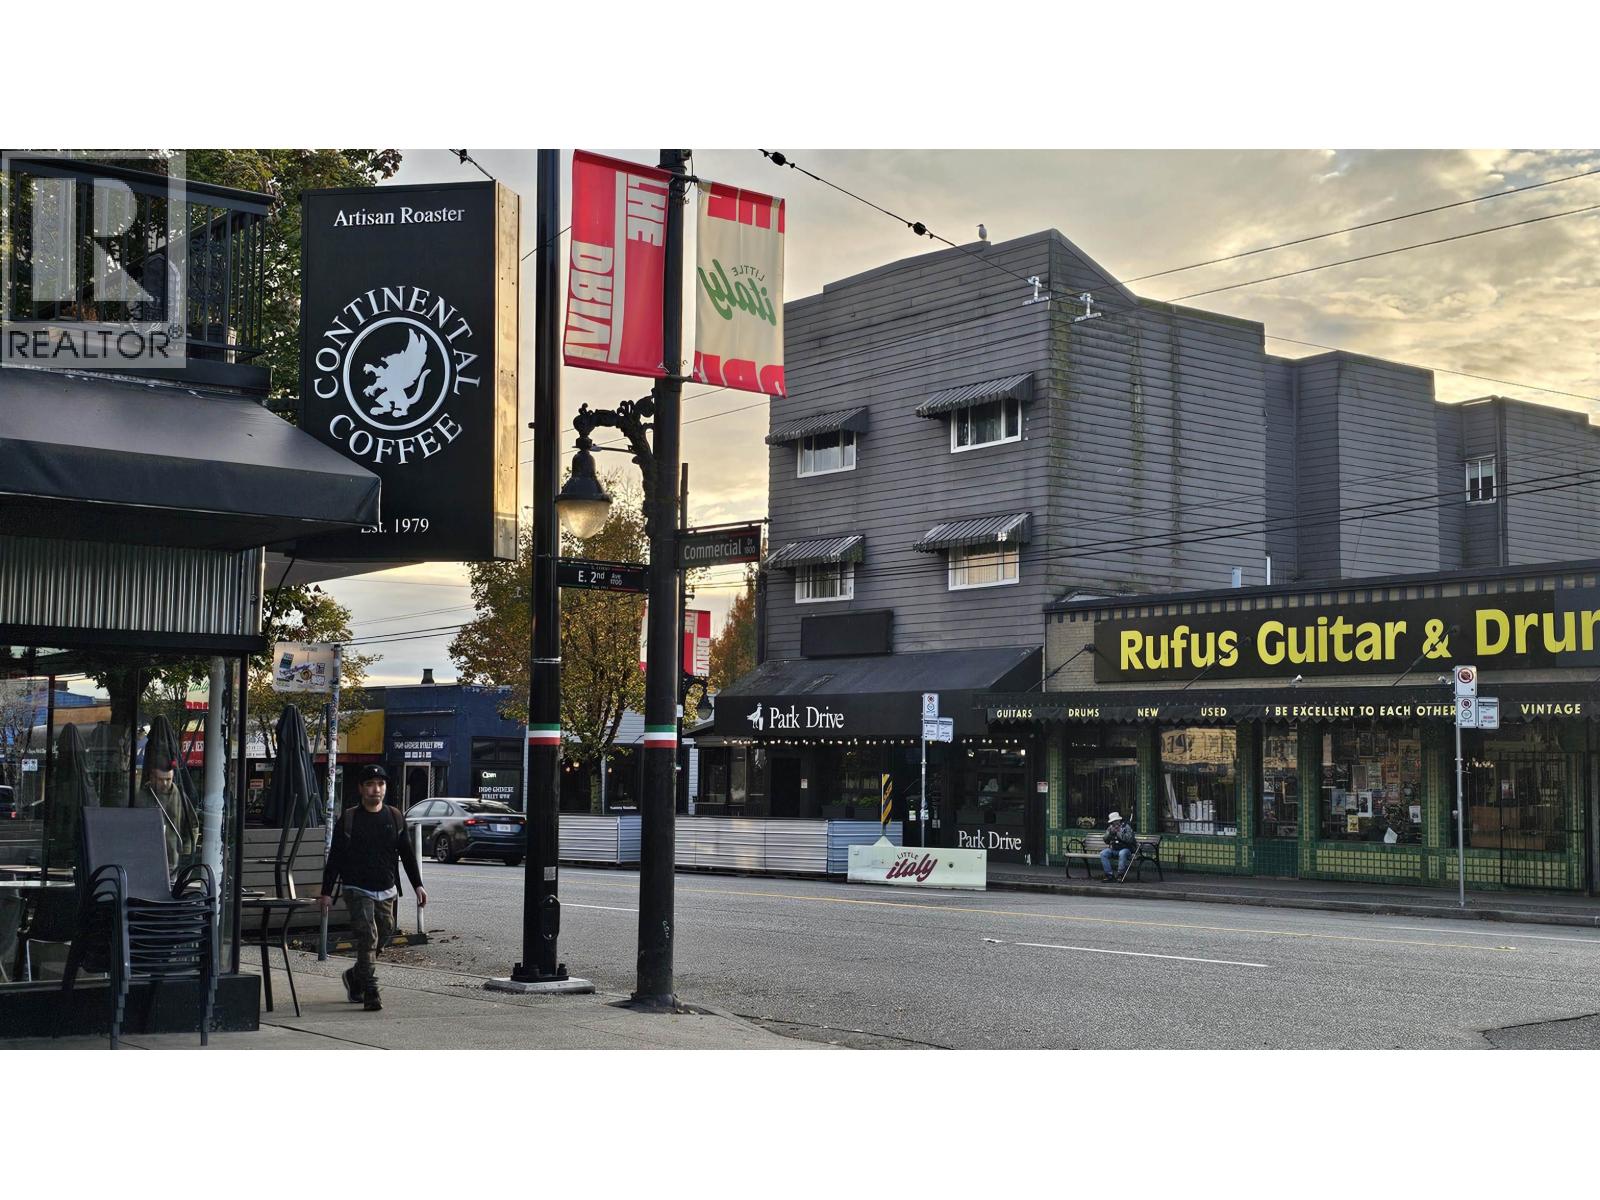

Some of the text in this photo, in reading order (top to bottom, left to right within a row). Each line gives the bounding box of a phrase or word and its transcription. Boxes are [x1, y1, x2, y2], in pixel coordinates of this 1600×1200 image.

[333, 206, 465, 227] Artisan Roaster
[313, 285, 480, 400] CONTINENTAL
[329, 412, 462, 465] COFFEE
[395, 518, 429, 533] 1979
[684, 538, 742, 560] Commercial
[578, 570, 605, 584] E. 2nd
[1120, 624, 1239, 671] Rufus
[1256, 616, 1407, 665] Guitar
[1422, 618, 1453, 659] &
[769, 704, 845, 729] Park Drive
[996, 708, 1033, 719] GUITARS
[1068, 707, 1100, 718] DRUMS
[1137, 707, 1159, 718] NEW
[1201, 706, 1227, 717] USED
[1275, 704, 1456, 717] BE EXCELLENT TO EACH OTHER
[1521, 703, 1582, 716] VINTAGE
[957, 829, 1022, 851] Park Drive
[896, 851, 919, 861] LITTLE
[885, 853, 939, 882] italy
